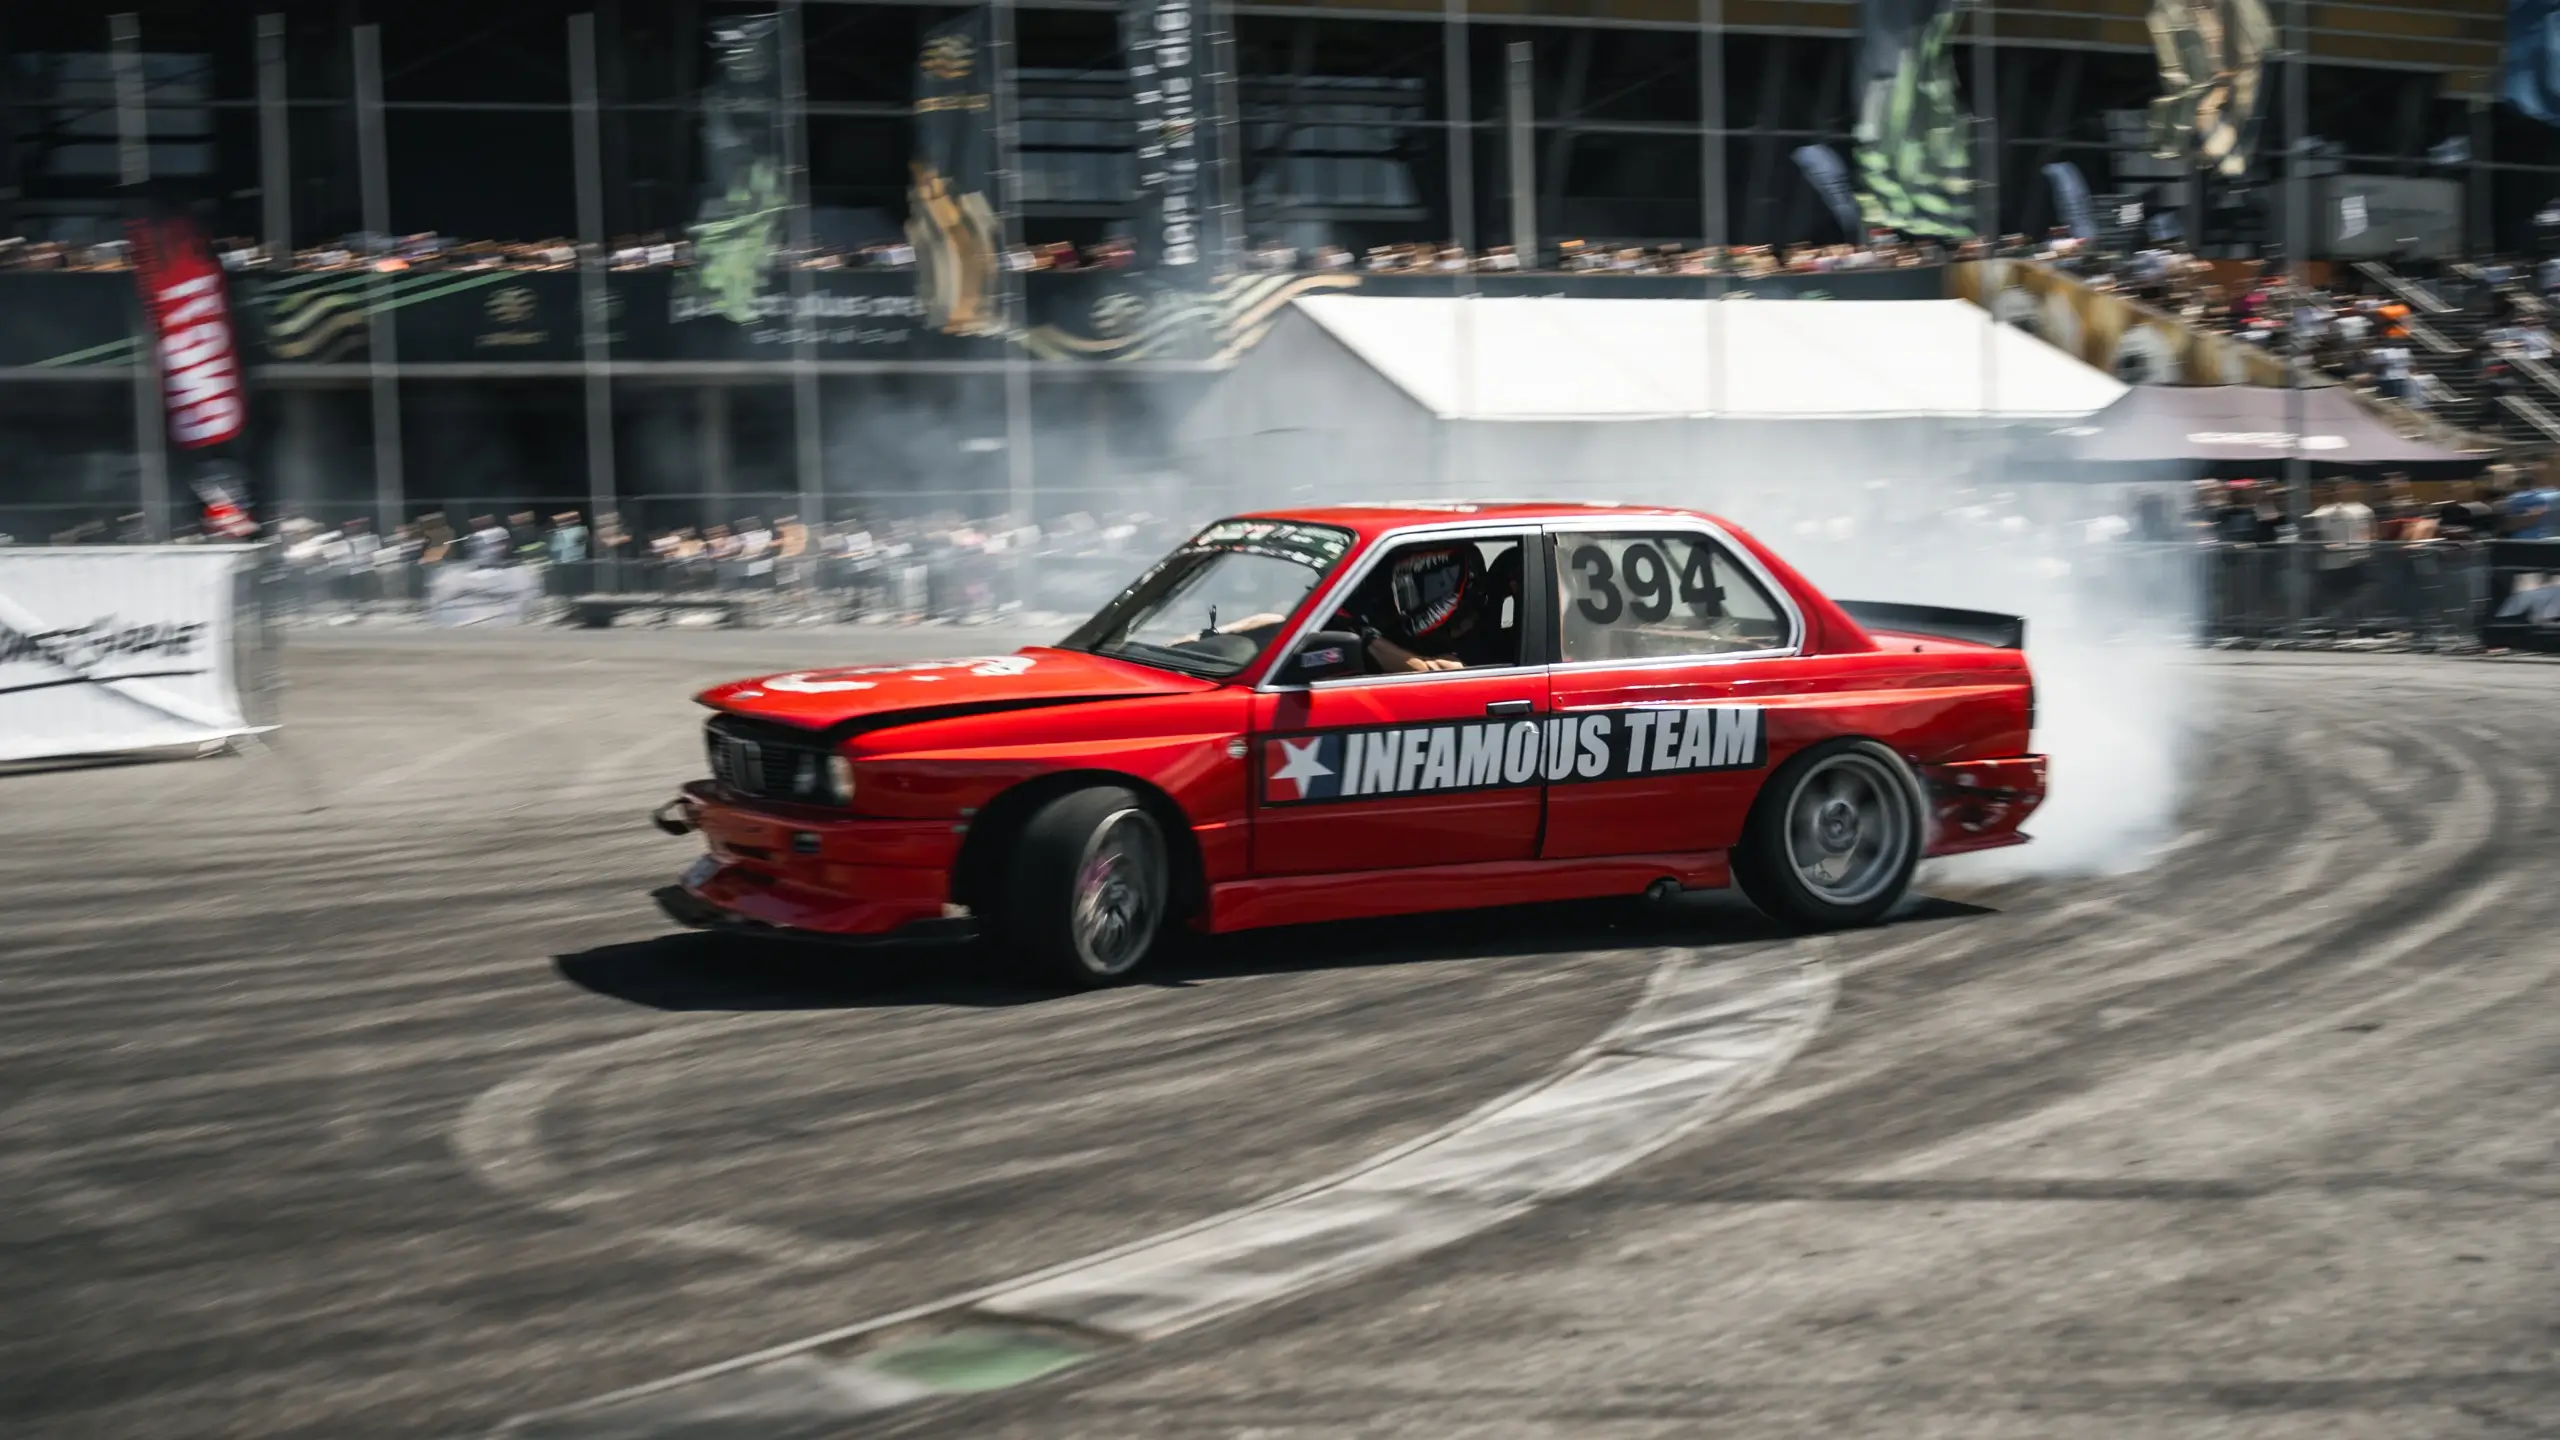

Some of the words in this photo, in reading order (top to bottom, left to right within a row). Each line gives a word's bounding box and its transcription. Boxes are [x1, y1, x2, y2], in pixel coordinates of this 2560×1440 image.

[1572, 542, 1726, 625] 394
[1340, 715, 1611, 796] INFAMOUS
[1625, 708, 1759, 773] TEAM
